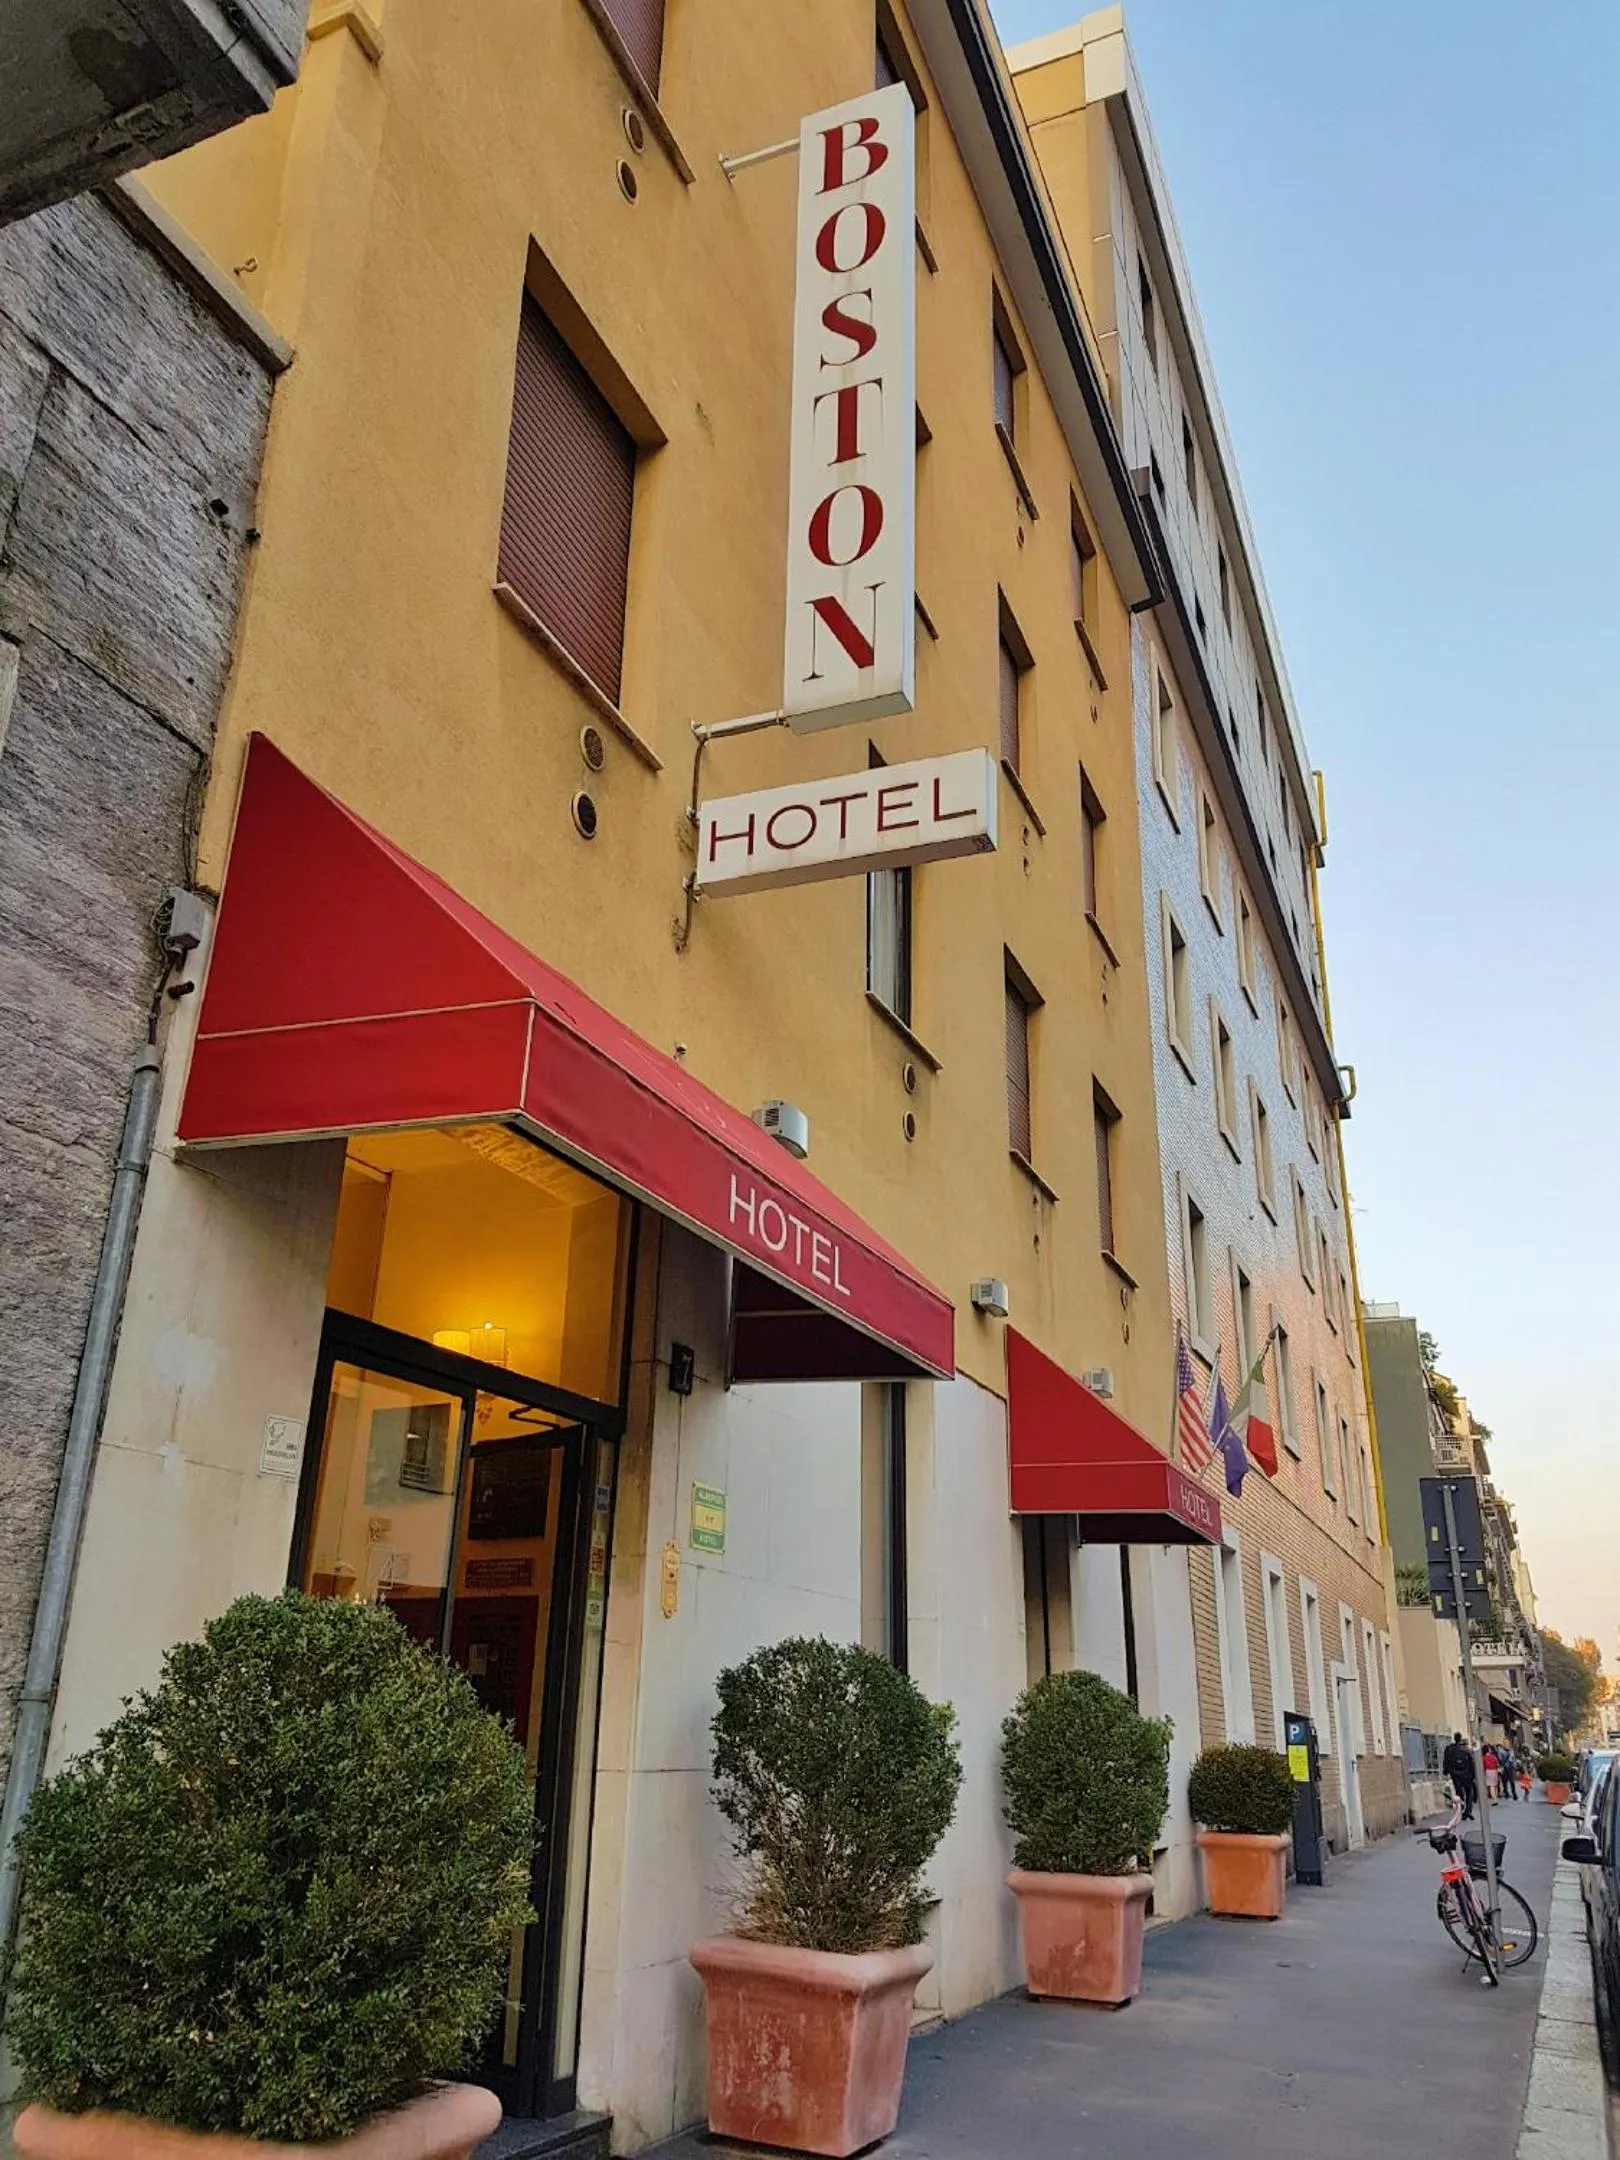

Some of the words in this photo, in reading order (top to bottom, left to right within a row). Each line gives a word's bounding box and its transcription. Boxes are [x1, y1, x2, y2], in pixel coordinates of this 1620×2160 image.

[803, 116, 889, 682] BOSTON
[707, 776, 978, 863] HOTEL
[729, 1173, 851, 1296] HOTEL
[1180, 1483, 1213, 1527] HOTEL
[1289, 1724, 1300, 1741] P
